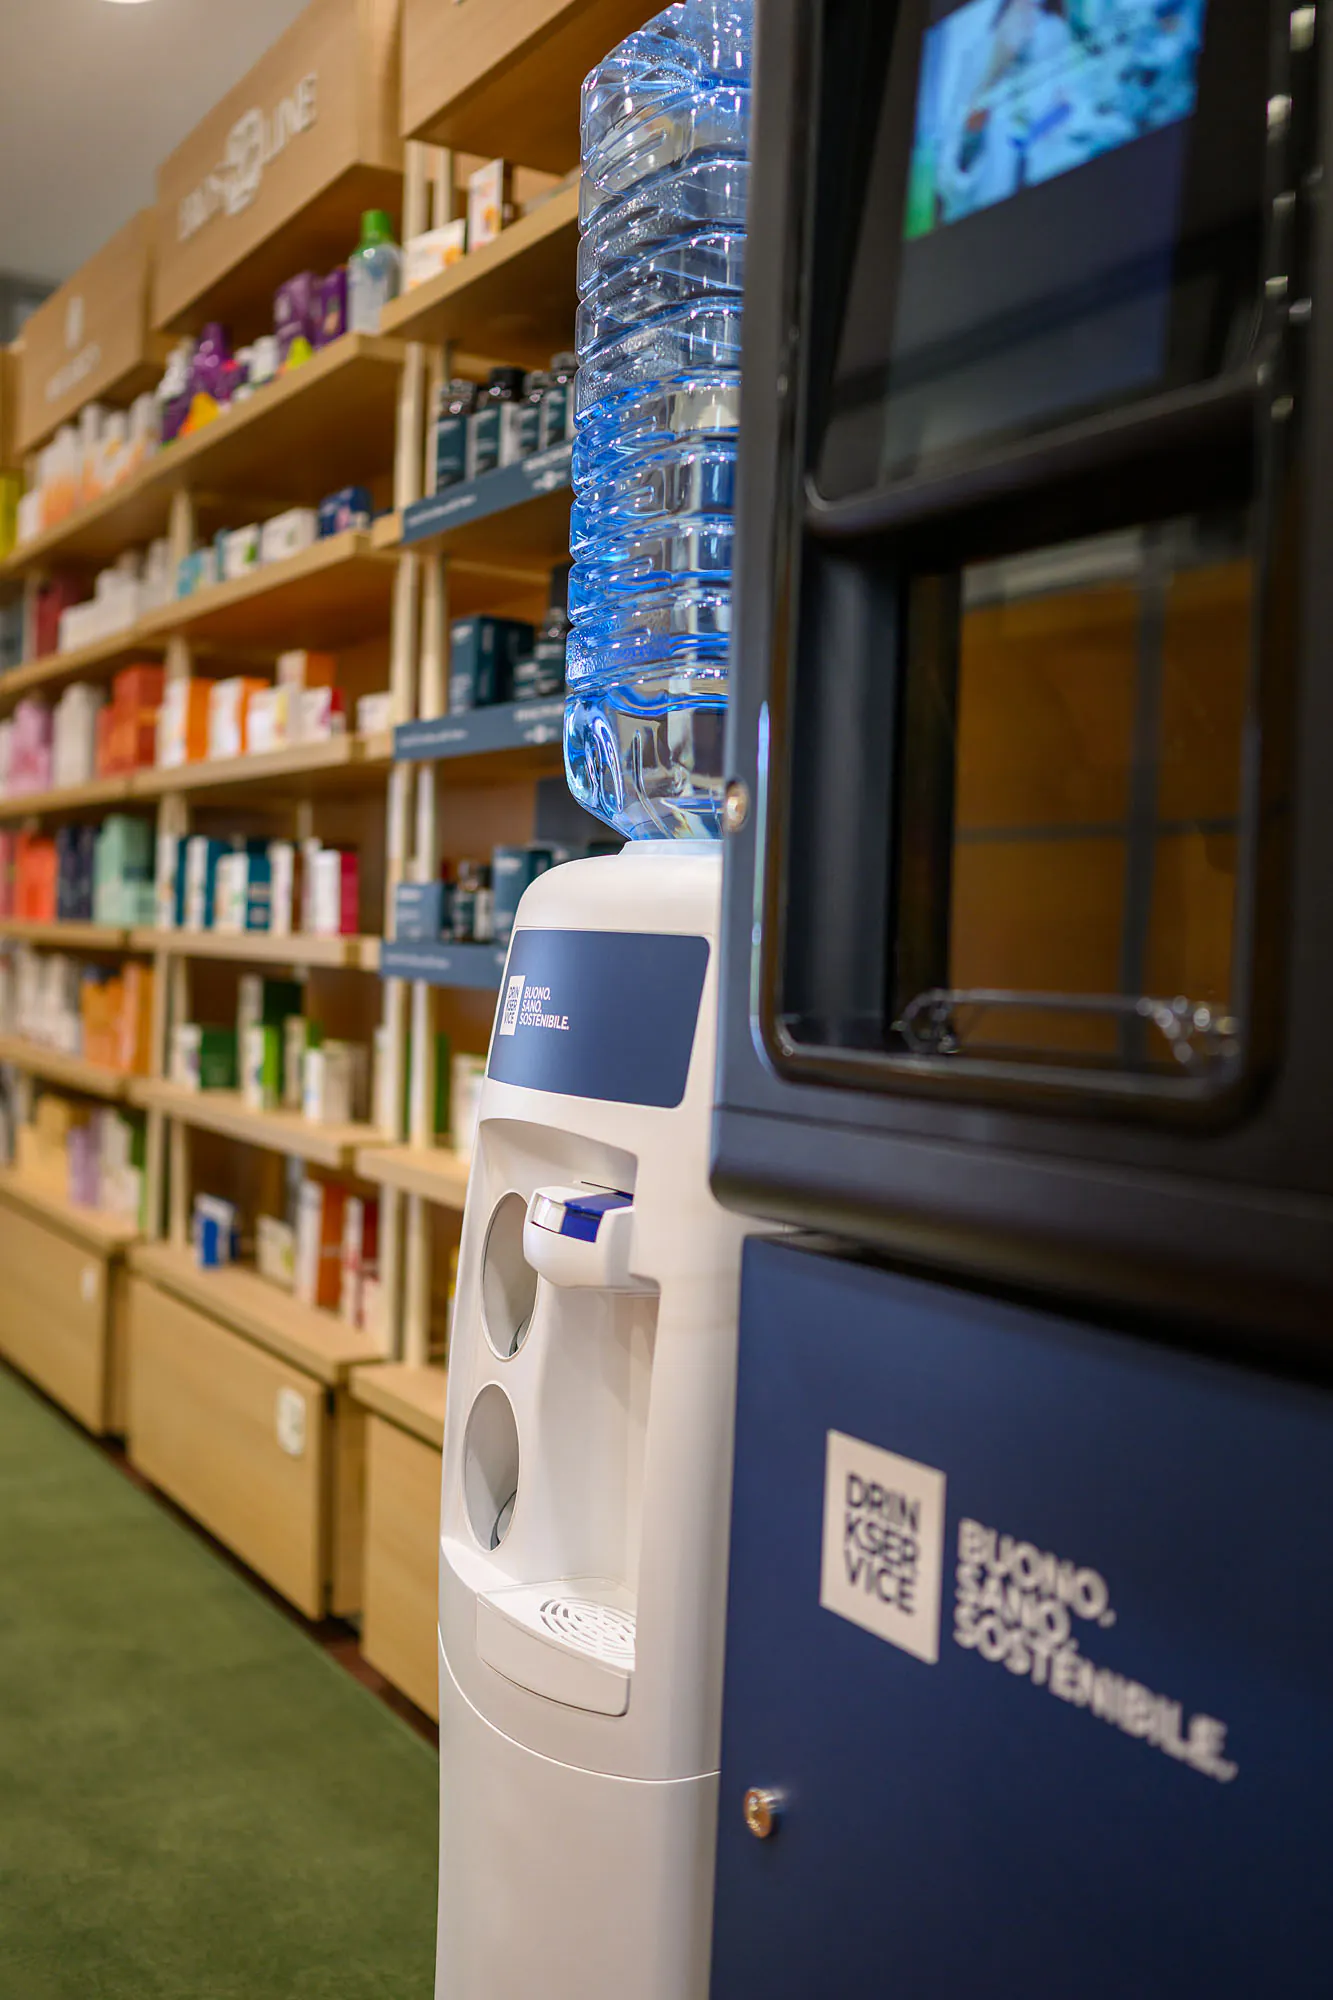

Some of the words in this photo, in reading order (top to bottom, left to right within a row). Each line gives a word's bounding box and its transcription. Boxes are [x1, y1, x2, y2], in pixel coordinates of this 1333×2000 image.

[519, 1013, 570, 1030] SOSTENIBILE.
[521, 1000, 542, 1013] SANO.
[524, 986, 551, 1000] BUONO.
[845, 1472, 921, 1533] DRIN
[844, 1512, 920, 1577] KSER
[957, 1517, 1118, 1628] BUONO.
[843, 1549, 916, 1617] VICE
[954, 1562, 1080, 1654] SANO.
[952, 1602, 1239, 1783] SOSTENIBILE.
